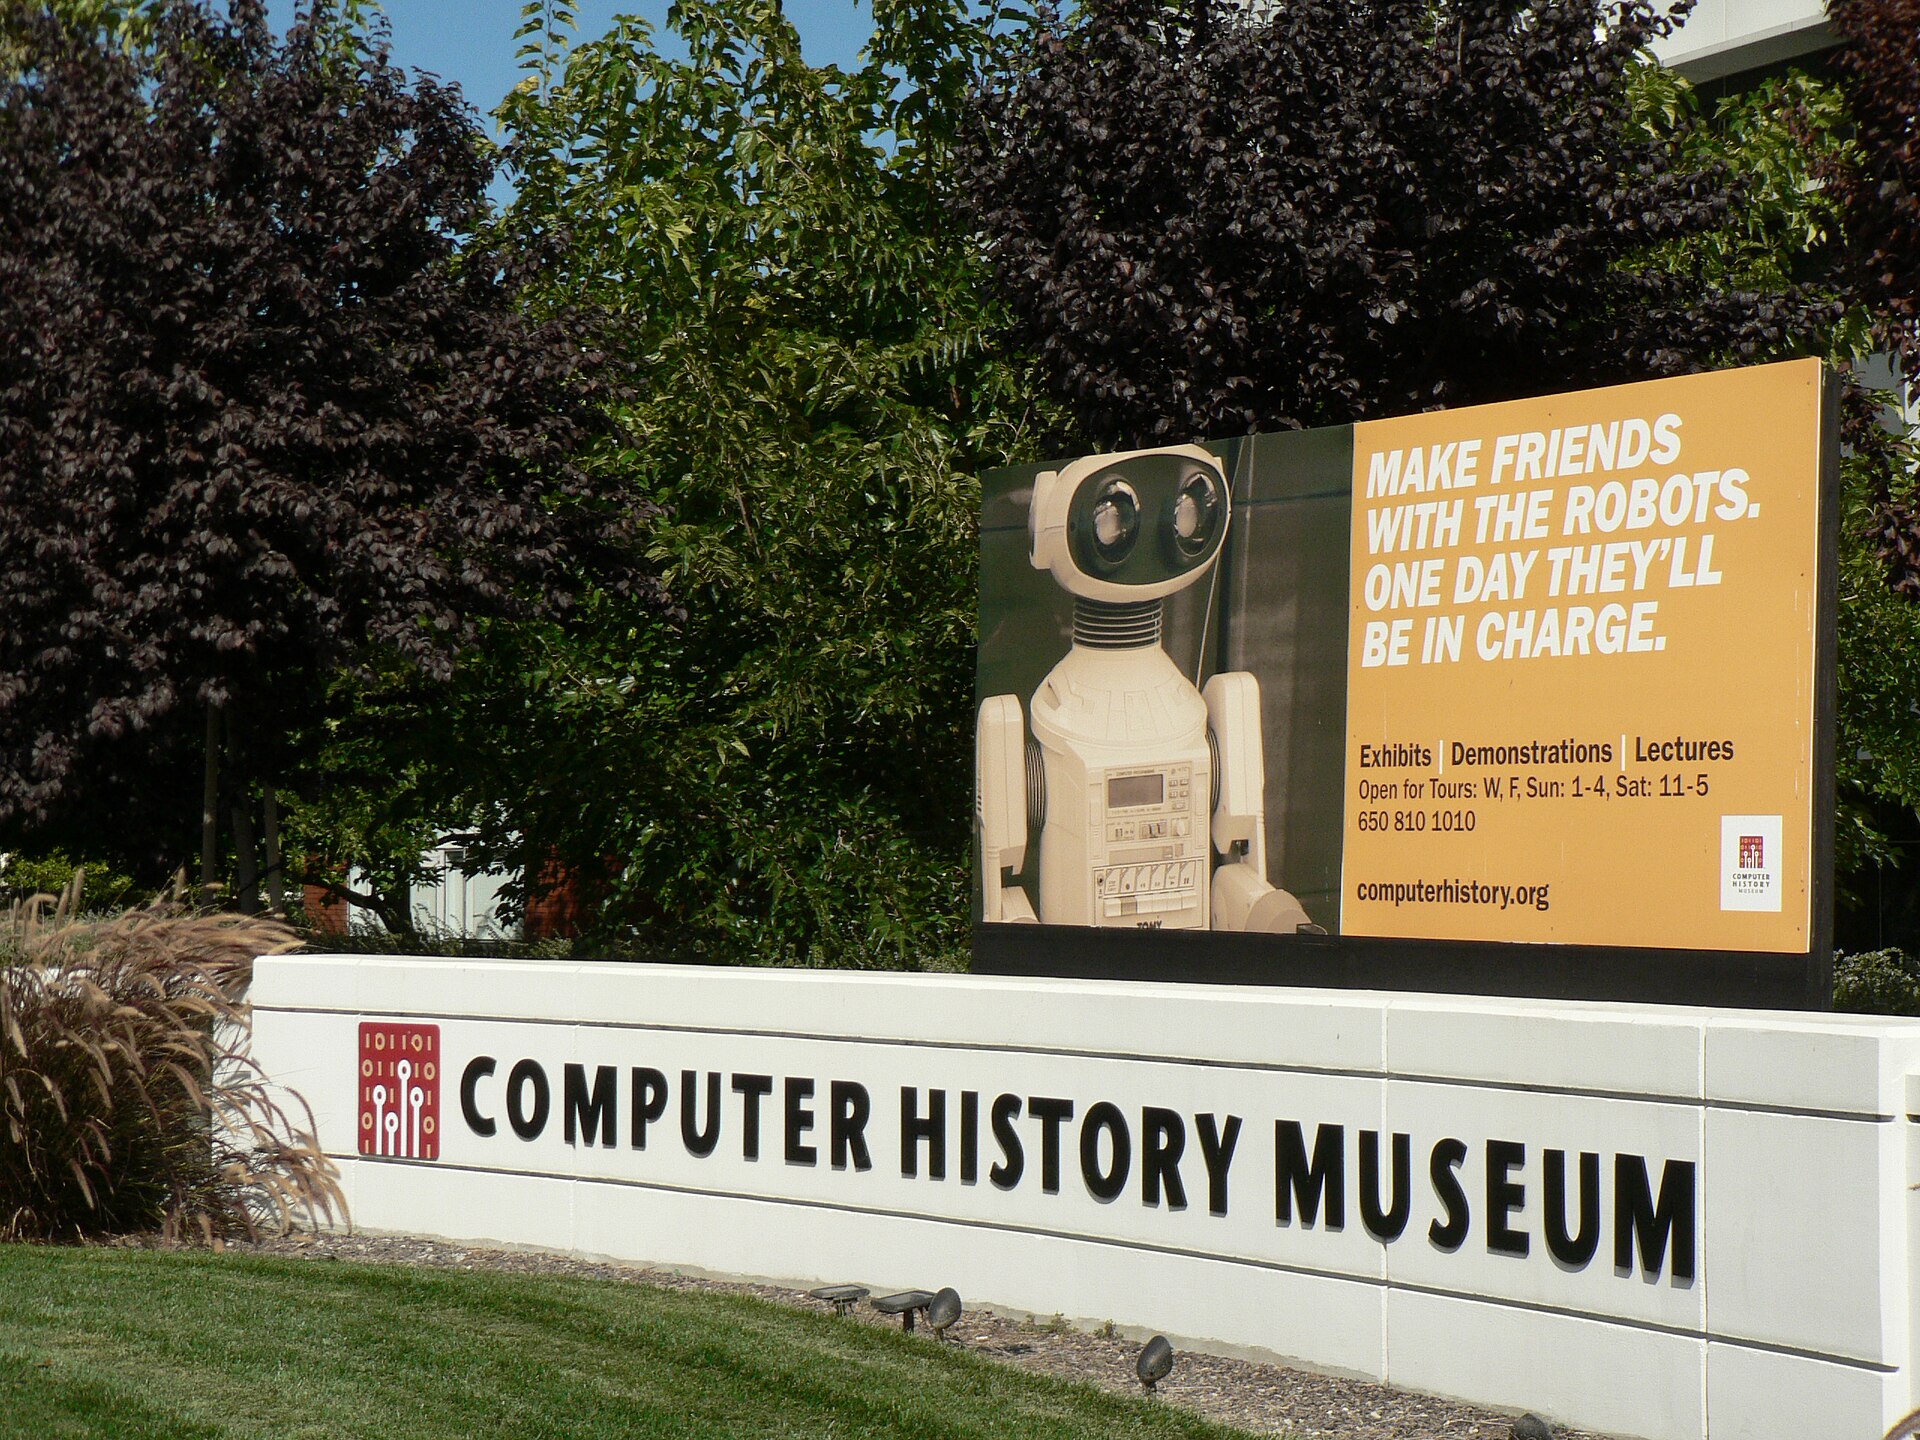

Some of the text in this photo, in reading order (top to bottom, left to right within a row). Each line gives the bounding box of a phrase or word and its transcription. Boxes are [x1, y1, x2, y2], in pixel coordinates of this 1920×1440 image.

[1366, 413, 1683, 498] MAKE FRIENDS
[1367, 468, 1760, 555] WITH THE ROBOTS.
[1364, 534, 1722, 611] ONE DAY THEY'LL
[1361, 601, 1667, 668] BE IN CHARGE.
[1360, 736, 1734, 768] Exhibits Demonstrations Lectures
[1358, 810, 1476, 832] 650 810 1010
[1359, 773, 1709, 804] Open for Tours: W, F, Sun: 1-4, Sat: 11-5
[1357, 879, 1550, 911] computerhistory.org
[460, 1055, 1695, 1288] COMPUTER HISTORY MUSEUM
